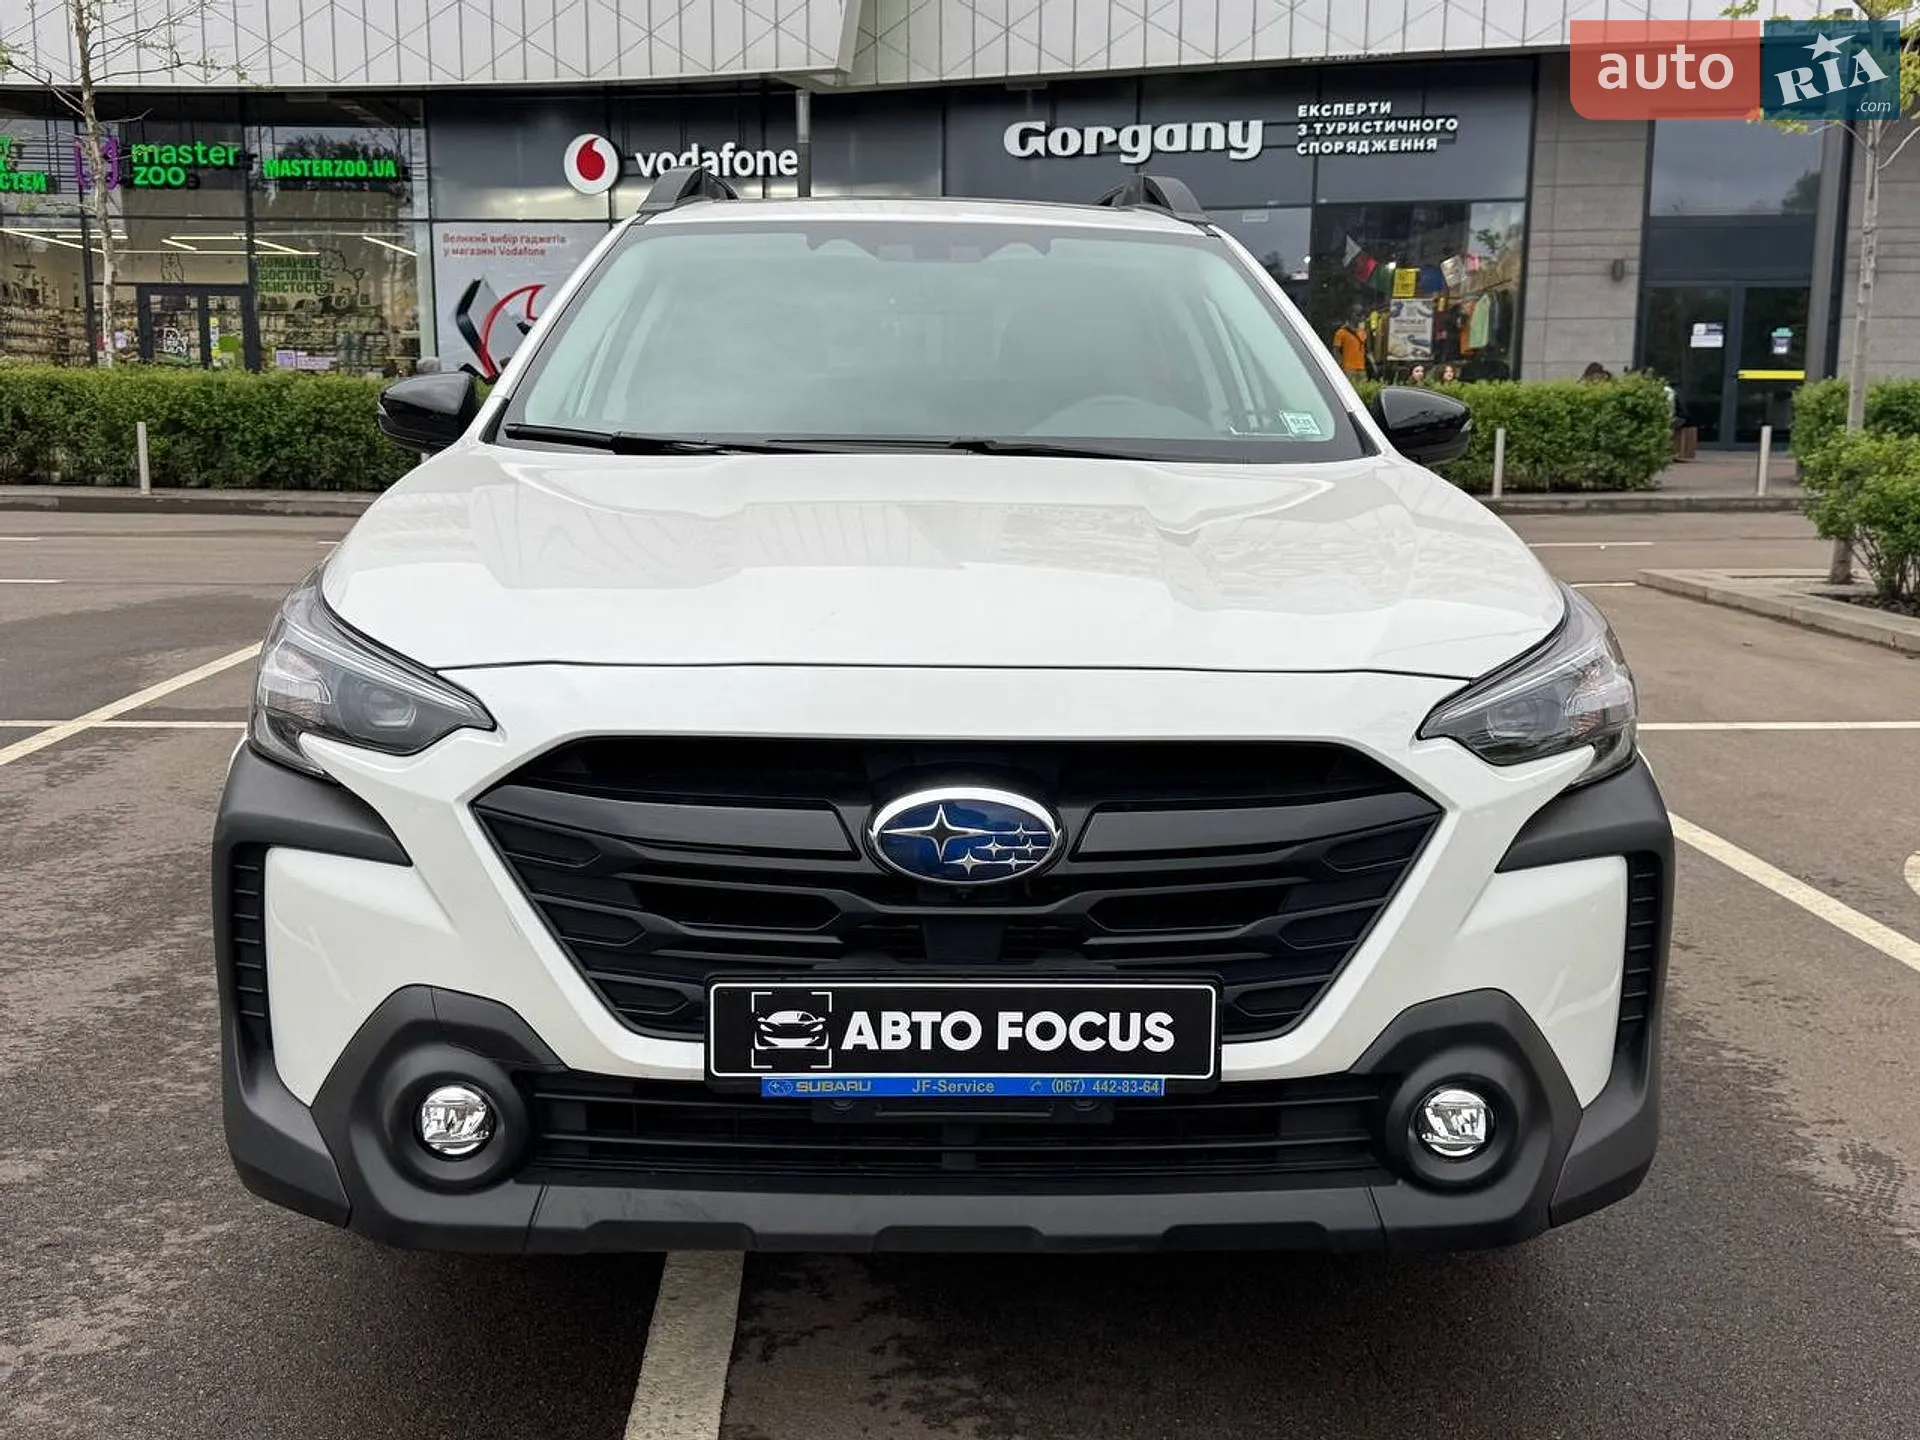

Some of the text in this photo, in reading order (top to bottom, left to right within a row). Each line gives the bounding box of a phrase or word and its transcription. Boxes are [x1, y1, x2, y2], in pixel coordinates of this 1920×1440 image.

[1297, 101, 1392, 118] ЕКСПЕРТИ
[1297, 118, 1459, 136] З ТУРИСТИЧНОГО
[1003, 119, 1264, 165] Gorgany
[1296, 138, 1438, 155] СПОРЯДЖЕННЯ
[131, 140, 240, 166] master
[635, 142, 799, 178] vodafone
[132, 166, 186, 185] zoo
[263, 159, 397, 179] MASTERZOO.UA
[499, 247, 546, 256] Vodafone
[841, 1010, 1175, 1051] АВТО FOCUS
[795, 1079, 1160, 1095] SUBARU JF-Service (067) 442-83-64
